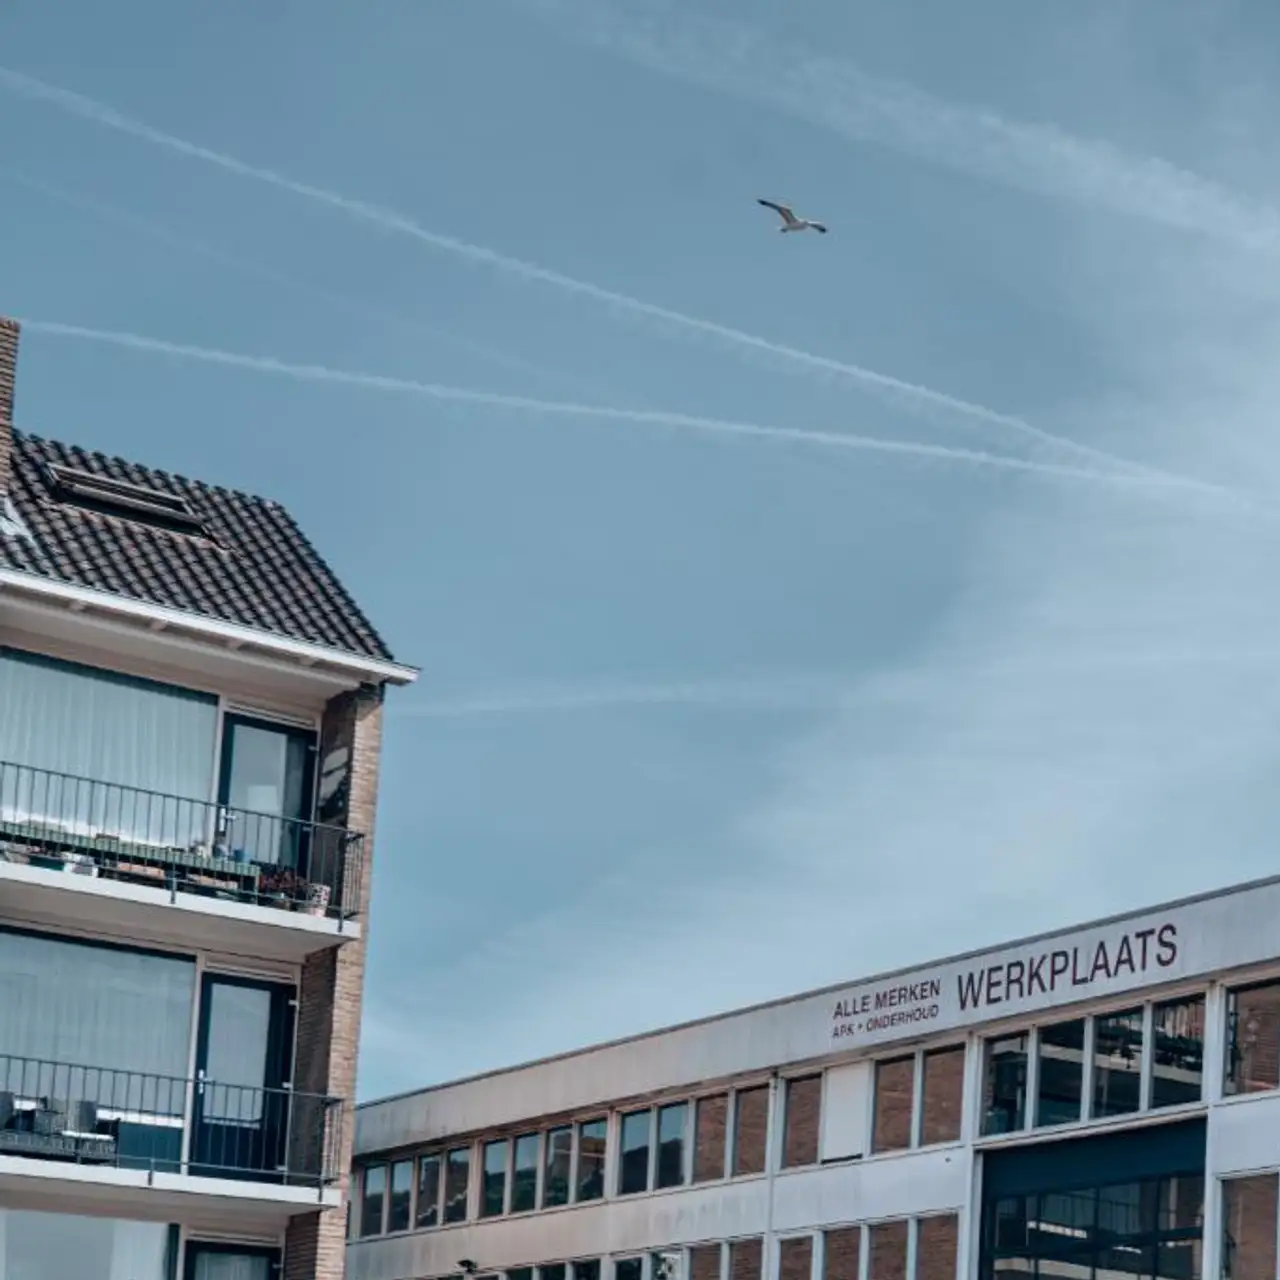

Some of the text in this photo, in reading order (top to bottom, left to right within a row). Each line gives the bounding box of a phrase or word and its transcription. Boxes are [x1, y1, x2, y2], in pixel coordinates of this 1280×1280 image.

[957, 922, 1179, 1012] WERKPLAATS
[832, 979, 941, 1020] ALLE MERKEN
[867, 1004, 939, 1032] ONDERHOUD
